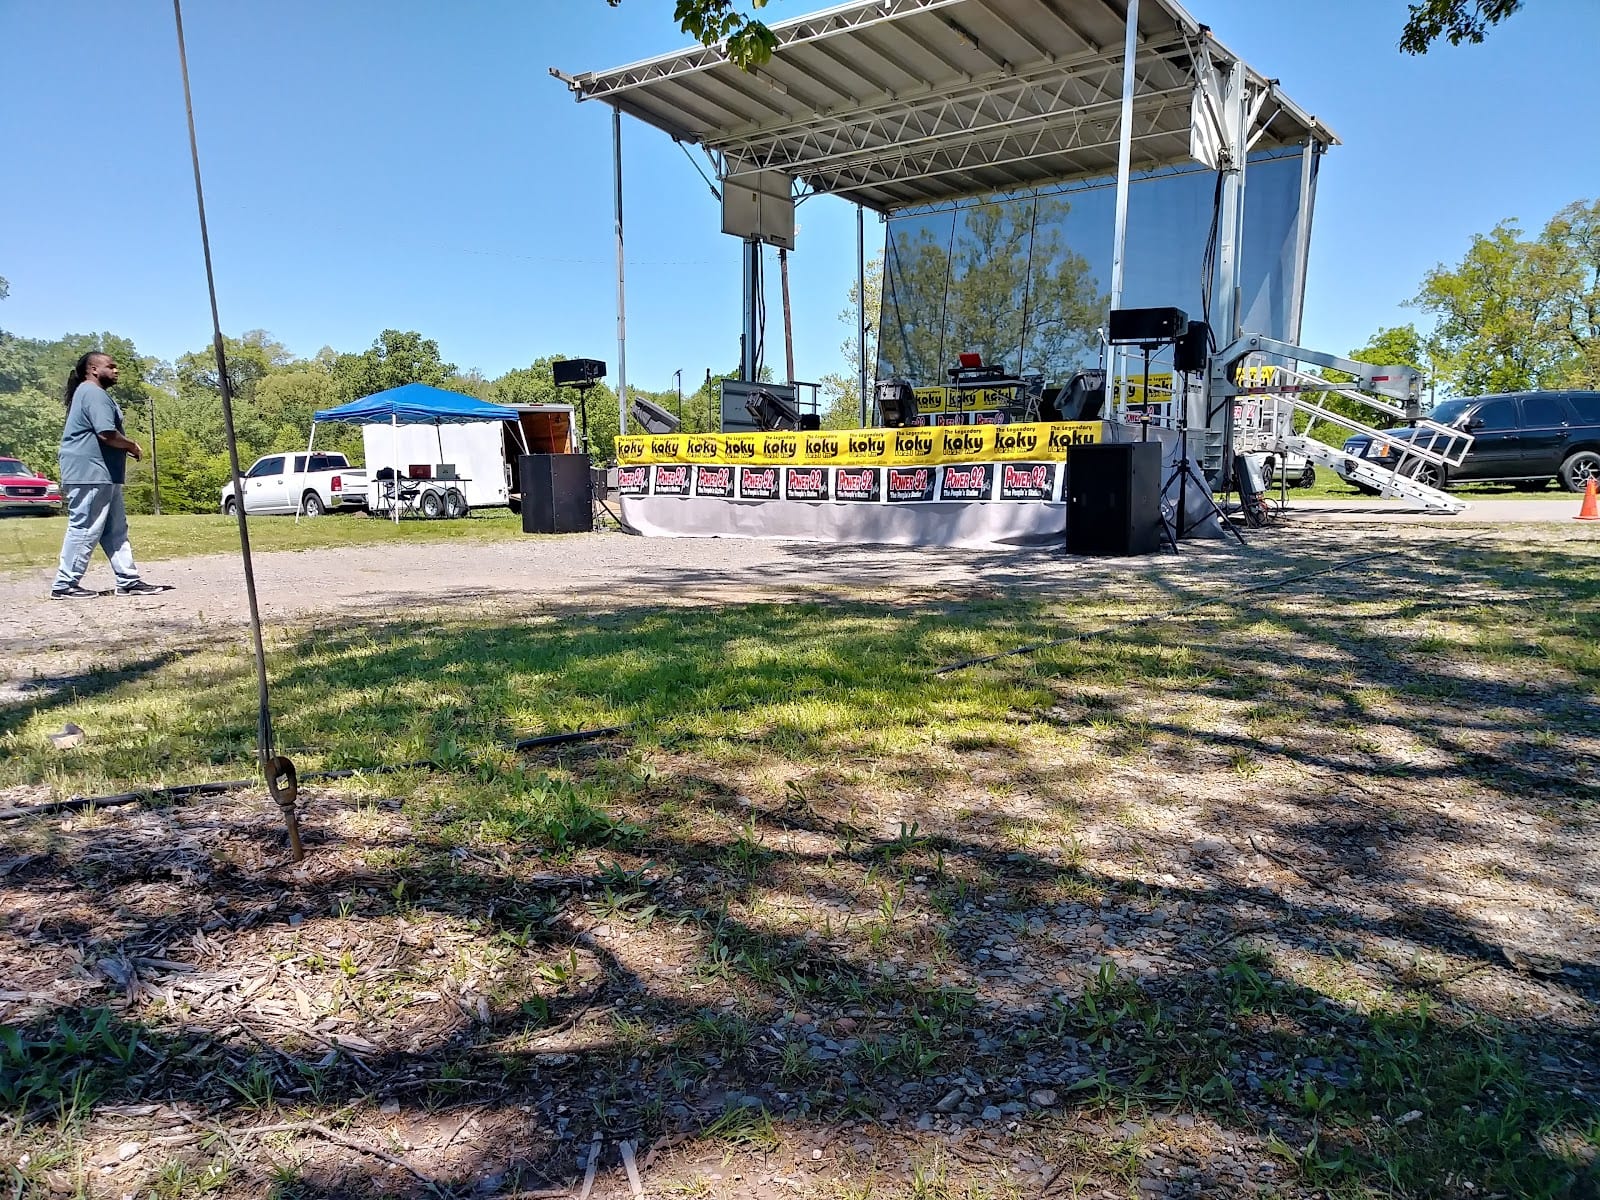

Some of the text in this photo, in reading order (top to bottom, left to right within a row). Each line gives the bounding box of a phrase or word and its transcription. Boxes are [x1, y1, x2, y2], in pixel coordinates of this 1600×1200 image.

[1006, 425, 1036, 433] Legendary
[618, 441, 644, 457] koky
[652, 440, 679, 457] koky
[687, 439, 717, 457] koky
[725, 440, 755, 458] koky
[763, 439, 797, 458] koky
[806, 439, 838, 457] koky
[849, 437, 885, 456] koky
[895, 435, 933, 455] koky
[943, 433, 983, 454] koky
[994, 431, 1038, 452] koky
[742, 469, 763, 489] POWER
[763, 469, 775, 489] 92
[788, 469, 810, 490] POWER
[810, 469, 822, 490] 92
[837, 470, 861, 490] POWER
[861, 470, 873, 490] 92
[890, 469, 927, 490] POWER 92
[944, 466, 985, 488] POWER 92
[1004, 465, 1047, 488] POWER 92
